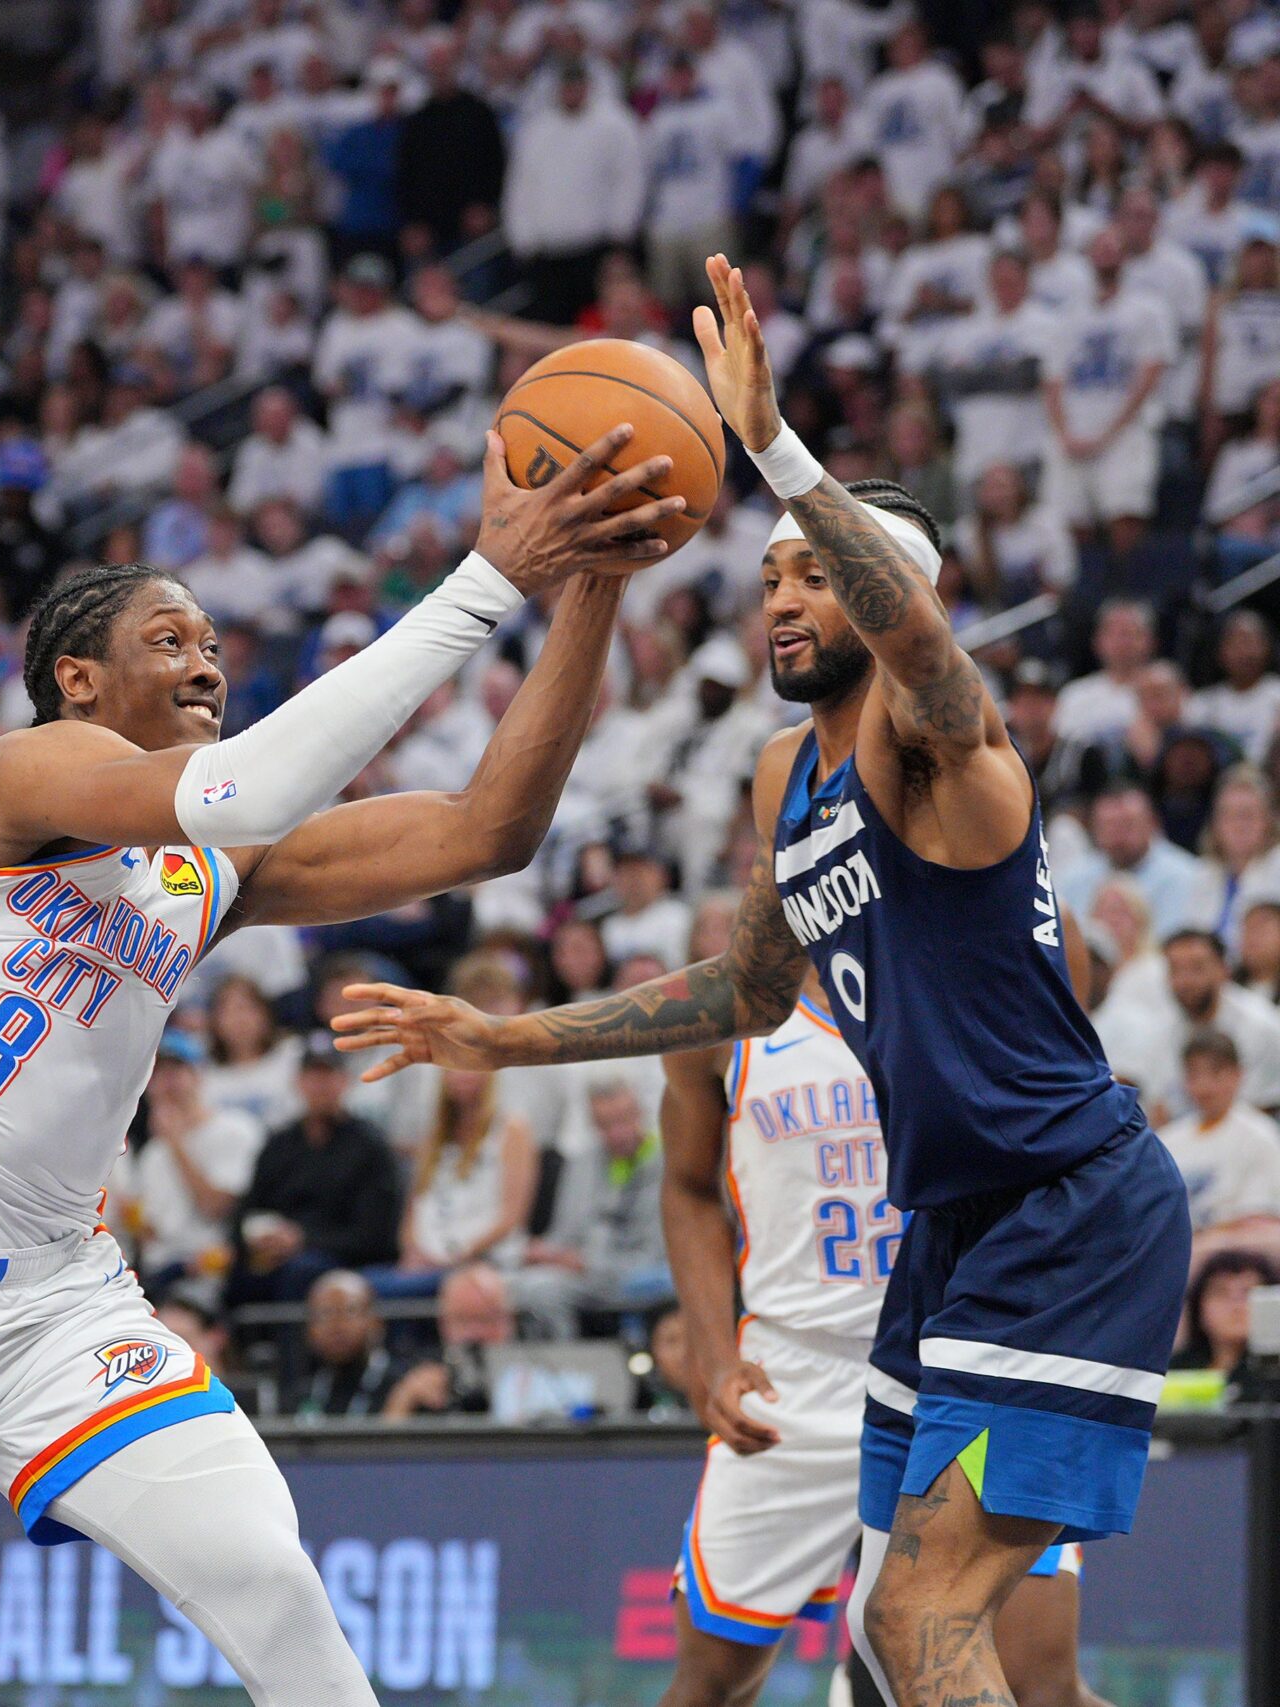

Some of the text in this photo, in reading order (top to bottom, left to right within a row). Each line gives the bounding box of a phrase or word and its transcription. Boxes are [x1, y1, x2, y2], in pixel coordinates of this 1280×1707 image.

[6, 869, 191, 1004] OKLAHOMA
[2, 936, 123, 1028] CITY
[830, 949, 866, 1023] 0
[746, 1076, 880, 1144] OKLAH
[815, 1137, 882, 1188] CIT
[812, 1191, 916, 1286] 22
[105, 1345, 153, 1387] OKC
[154, 1537, 500, 1690] SSON
